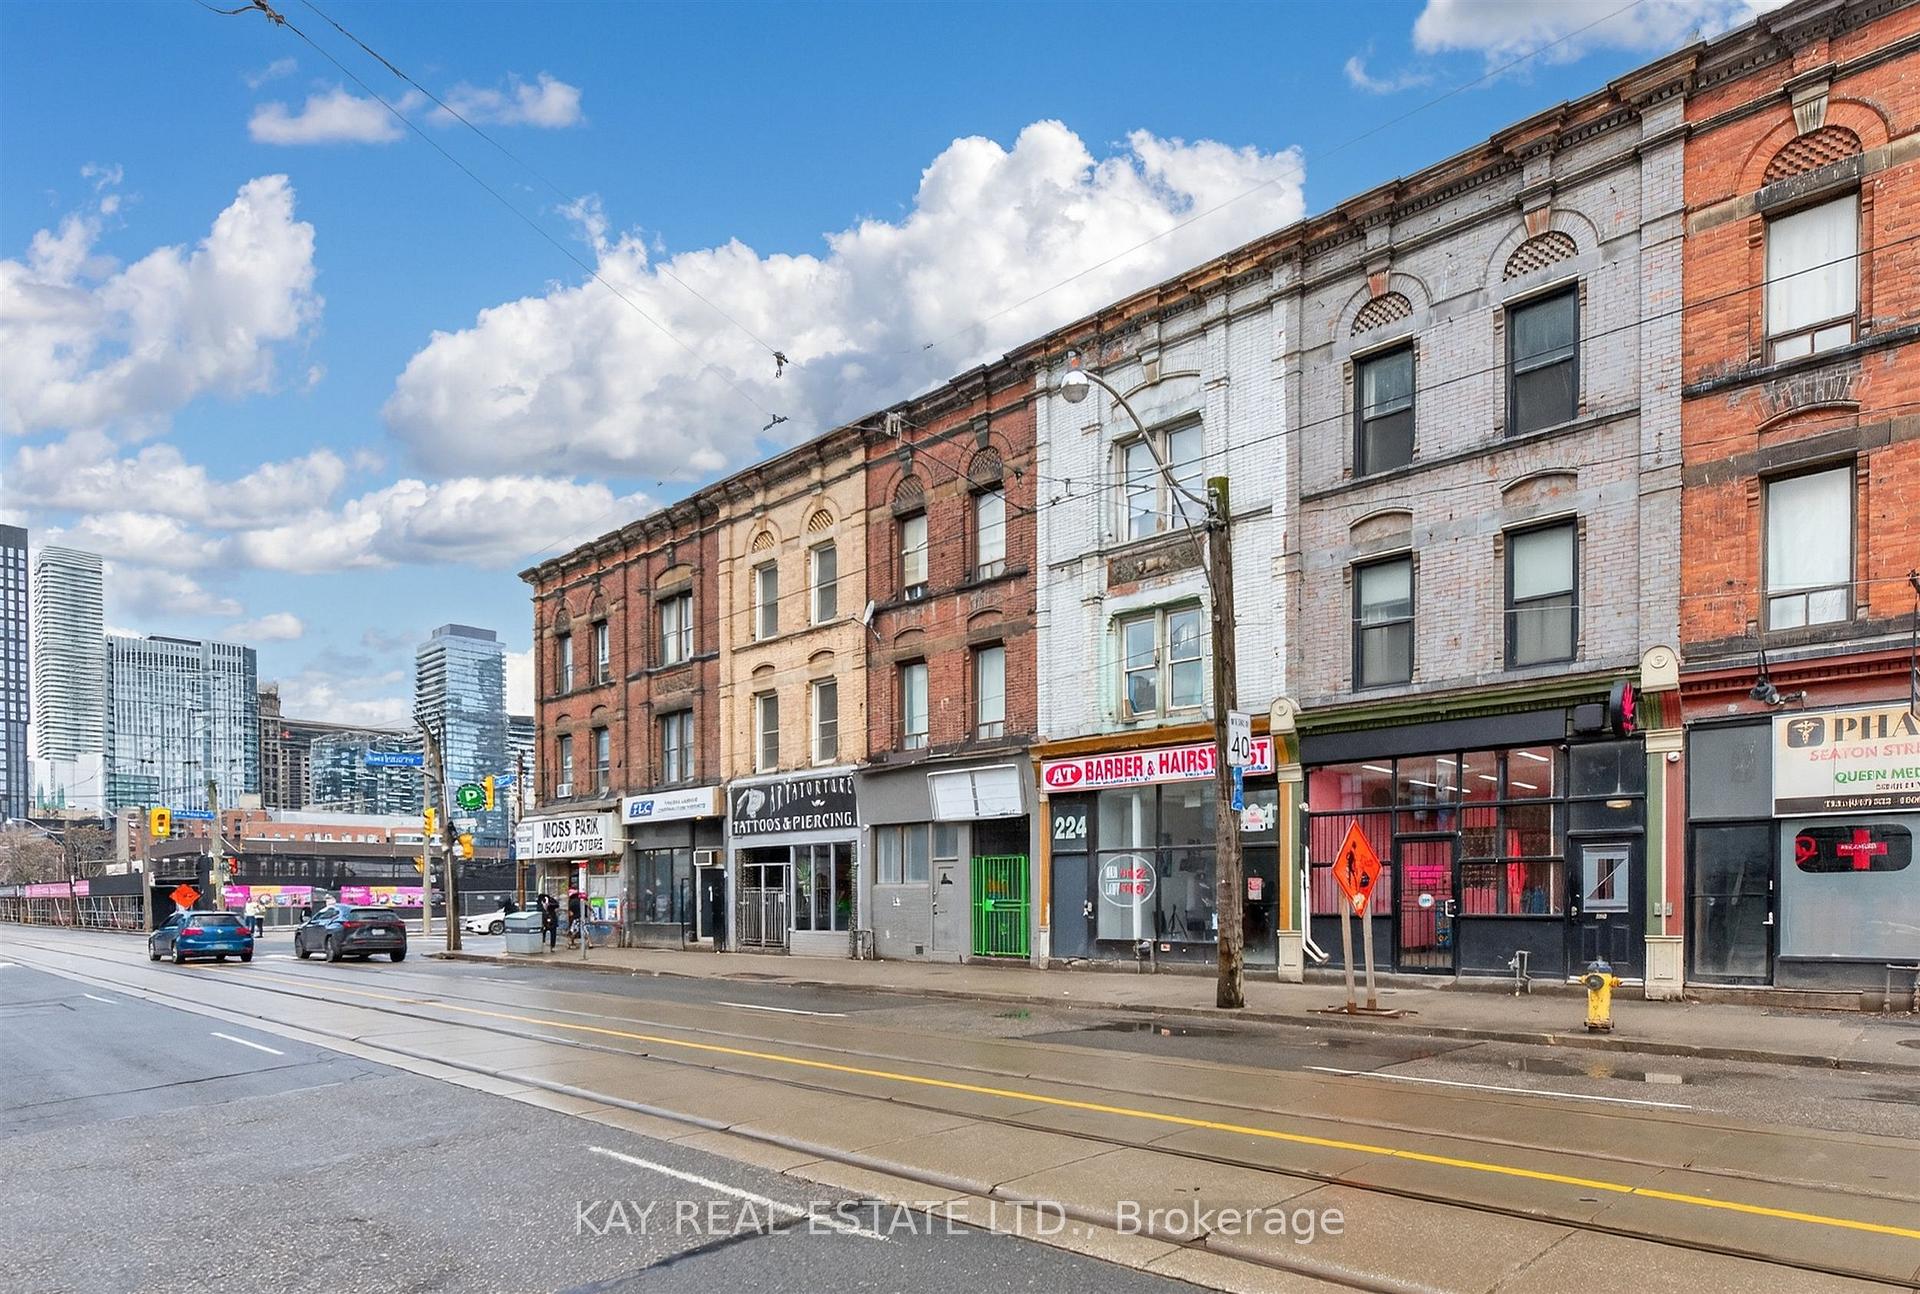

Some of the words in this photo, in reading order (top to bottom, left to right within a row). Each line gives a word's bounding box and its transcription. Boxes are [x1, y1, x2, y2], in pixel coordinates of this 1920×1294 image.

[1231, 734, 1250, 760] 40
[1809, 746, 1877, 761] SEATON
[1085, 756, 1143, 781] BARBER
[1147, 760, 1155, 776] &
[1835, 770, 1887, 784] QUEEN
[543, 820, 571, 839] MOSS
[575, 817, 599, 836] PARK
[733, 818, 780, 834] TATTOOS
[782, 817, 793, 831] &
[1054, 815, 1087, 839] 224
